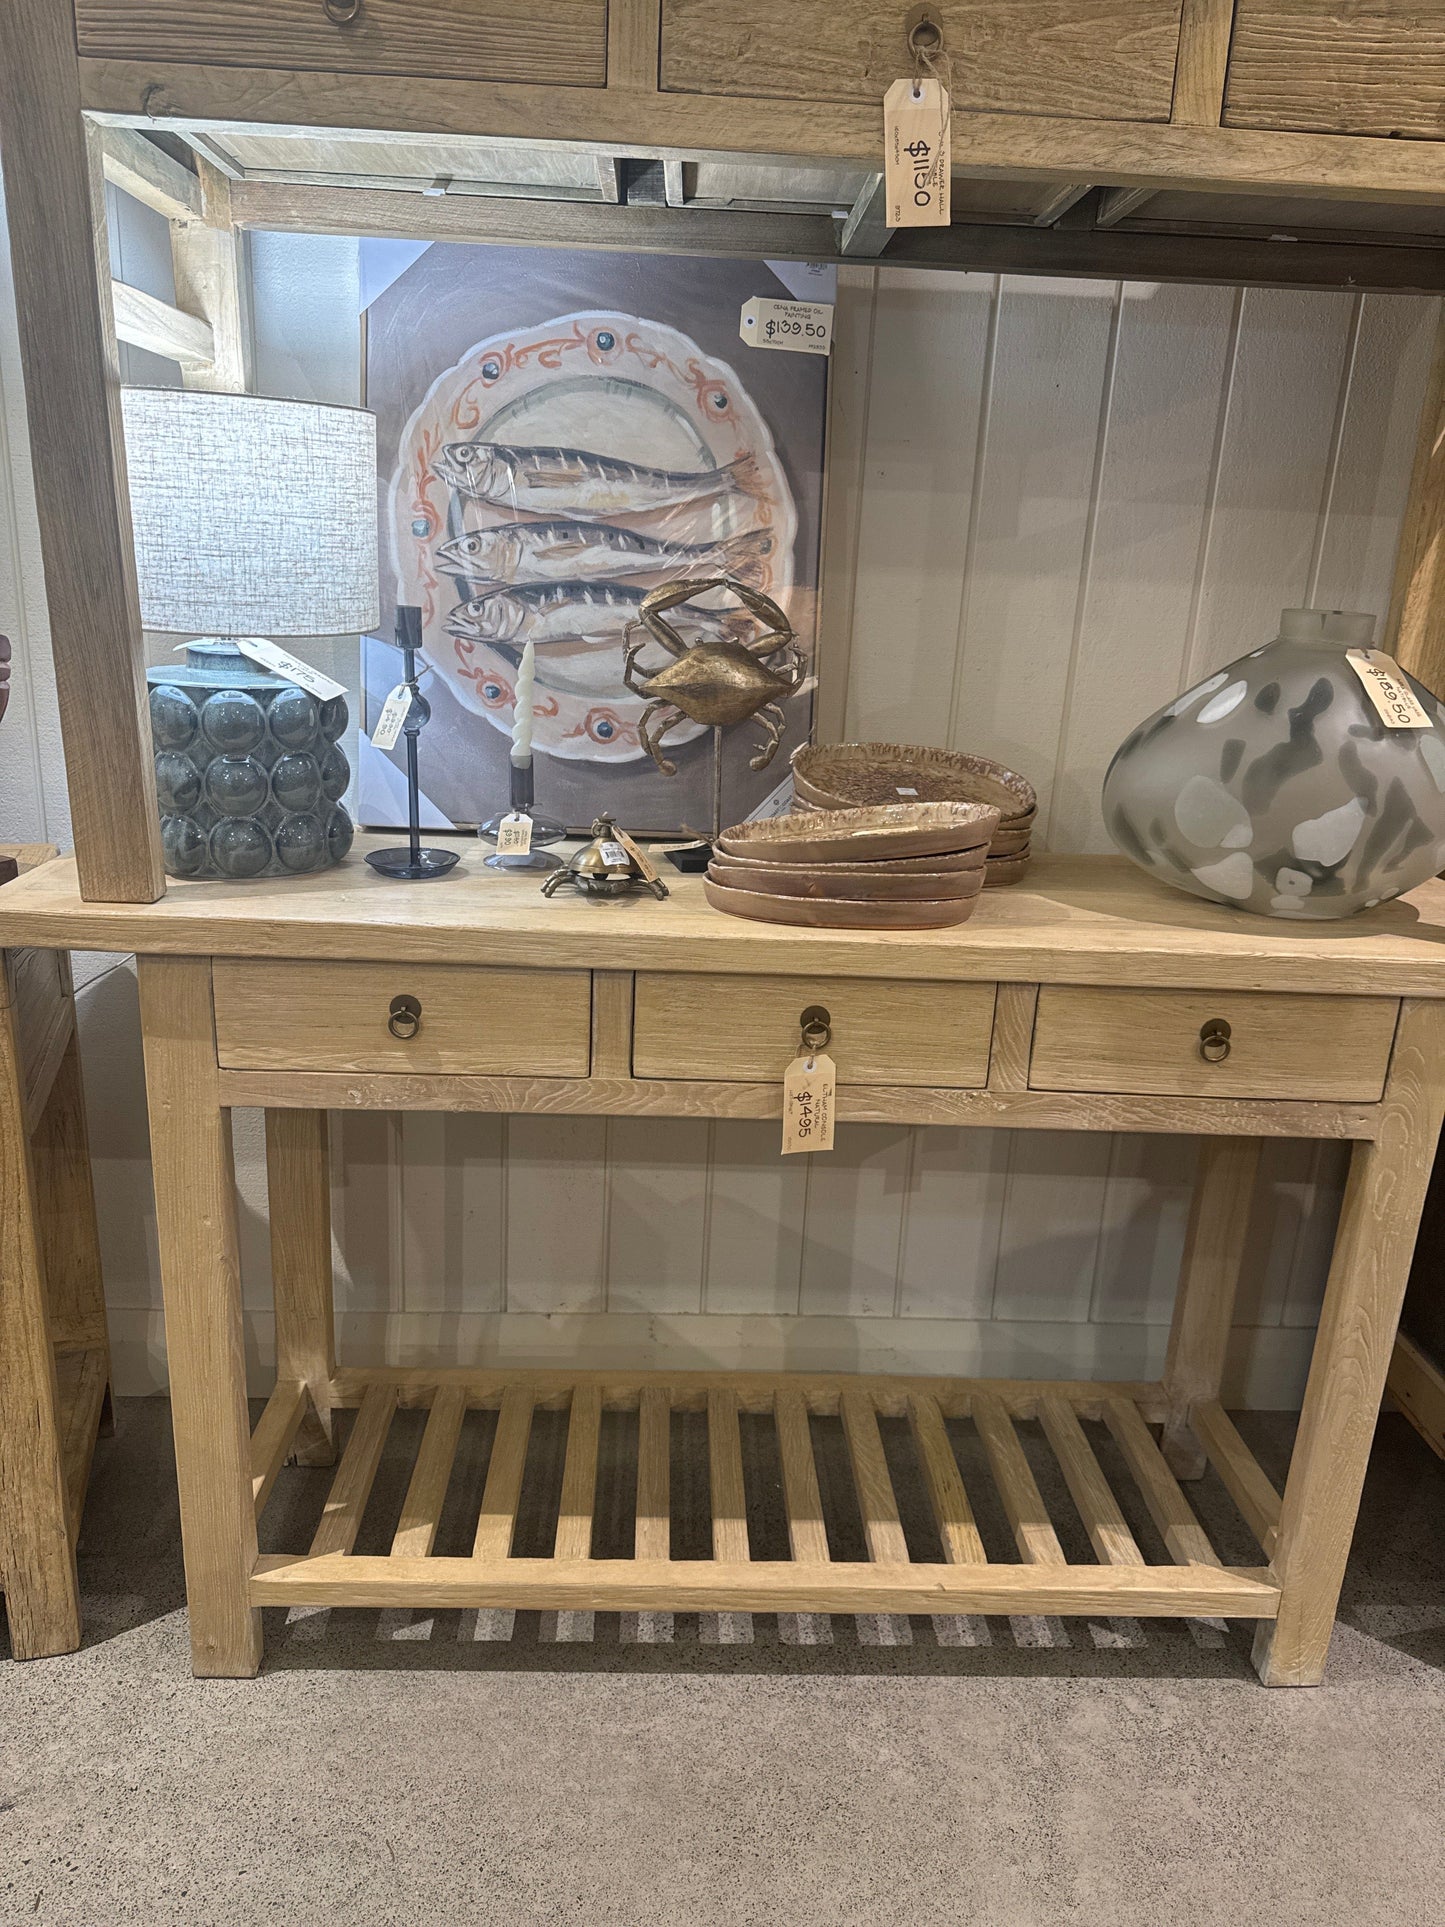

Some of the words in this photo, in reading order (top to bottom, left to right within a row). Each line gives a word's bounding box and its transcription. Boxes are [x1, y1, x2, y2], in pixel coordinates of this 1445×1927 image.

[904, 139, 931, 207] $1150
[765, 318, 826, 339] $139.50
[277, 660, 315, 683] $175
[1366, 667, 1411, 724] $189.50
[793, 1091, 813, 1138] $1495
